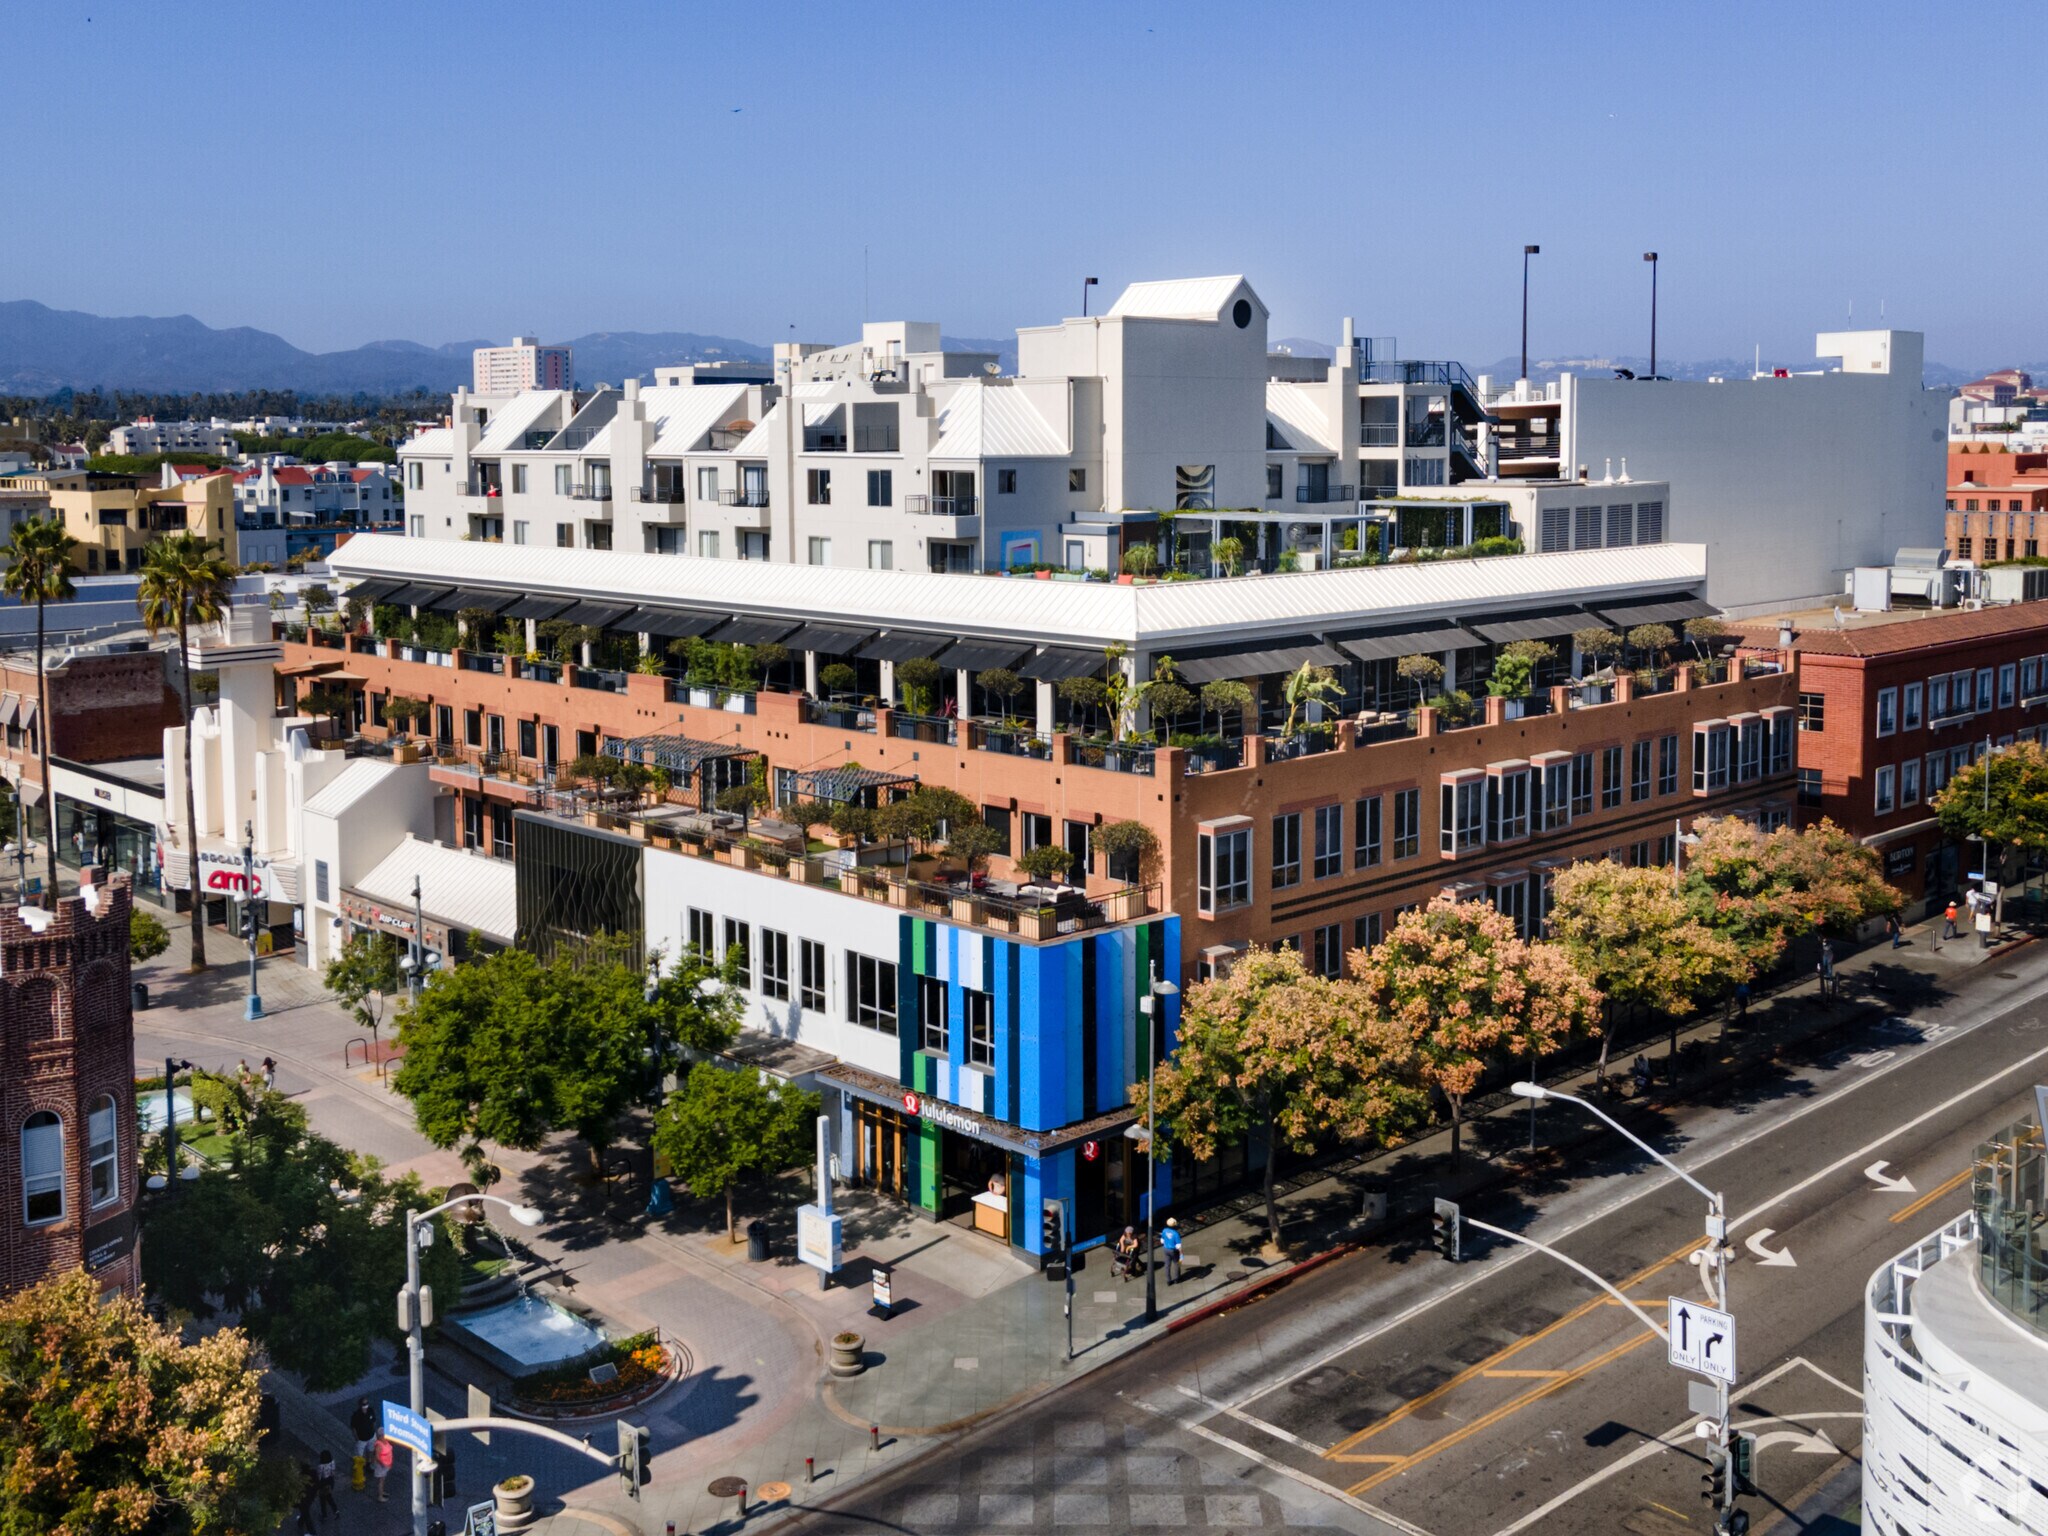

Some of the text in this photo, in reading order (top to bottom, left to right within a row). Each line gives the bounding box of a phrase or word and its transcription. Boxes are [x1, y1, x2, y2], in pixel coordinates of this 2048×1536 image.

[921, 1100, 980, 1135] lululemon
[1700, 1314, 1728, 1331] PARKING
[1672, 1350, 1696, 1364] ONLY
[1703, 1360, 1727, 1374] ONLY
[387, 1408, 429, 1438] Third Street
[389, 1423, 428, 1451] Promenade
